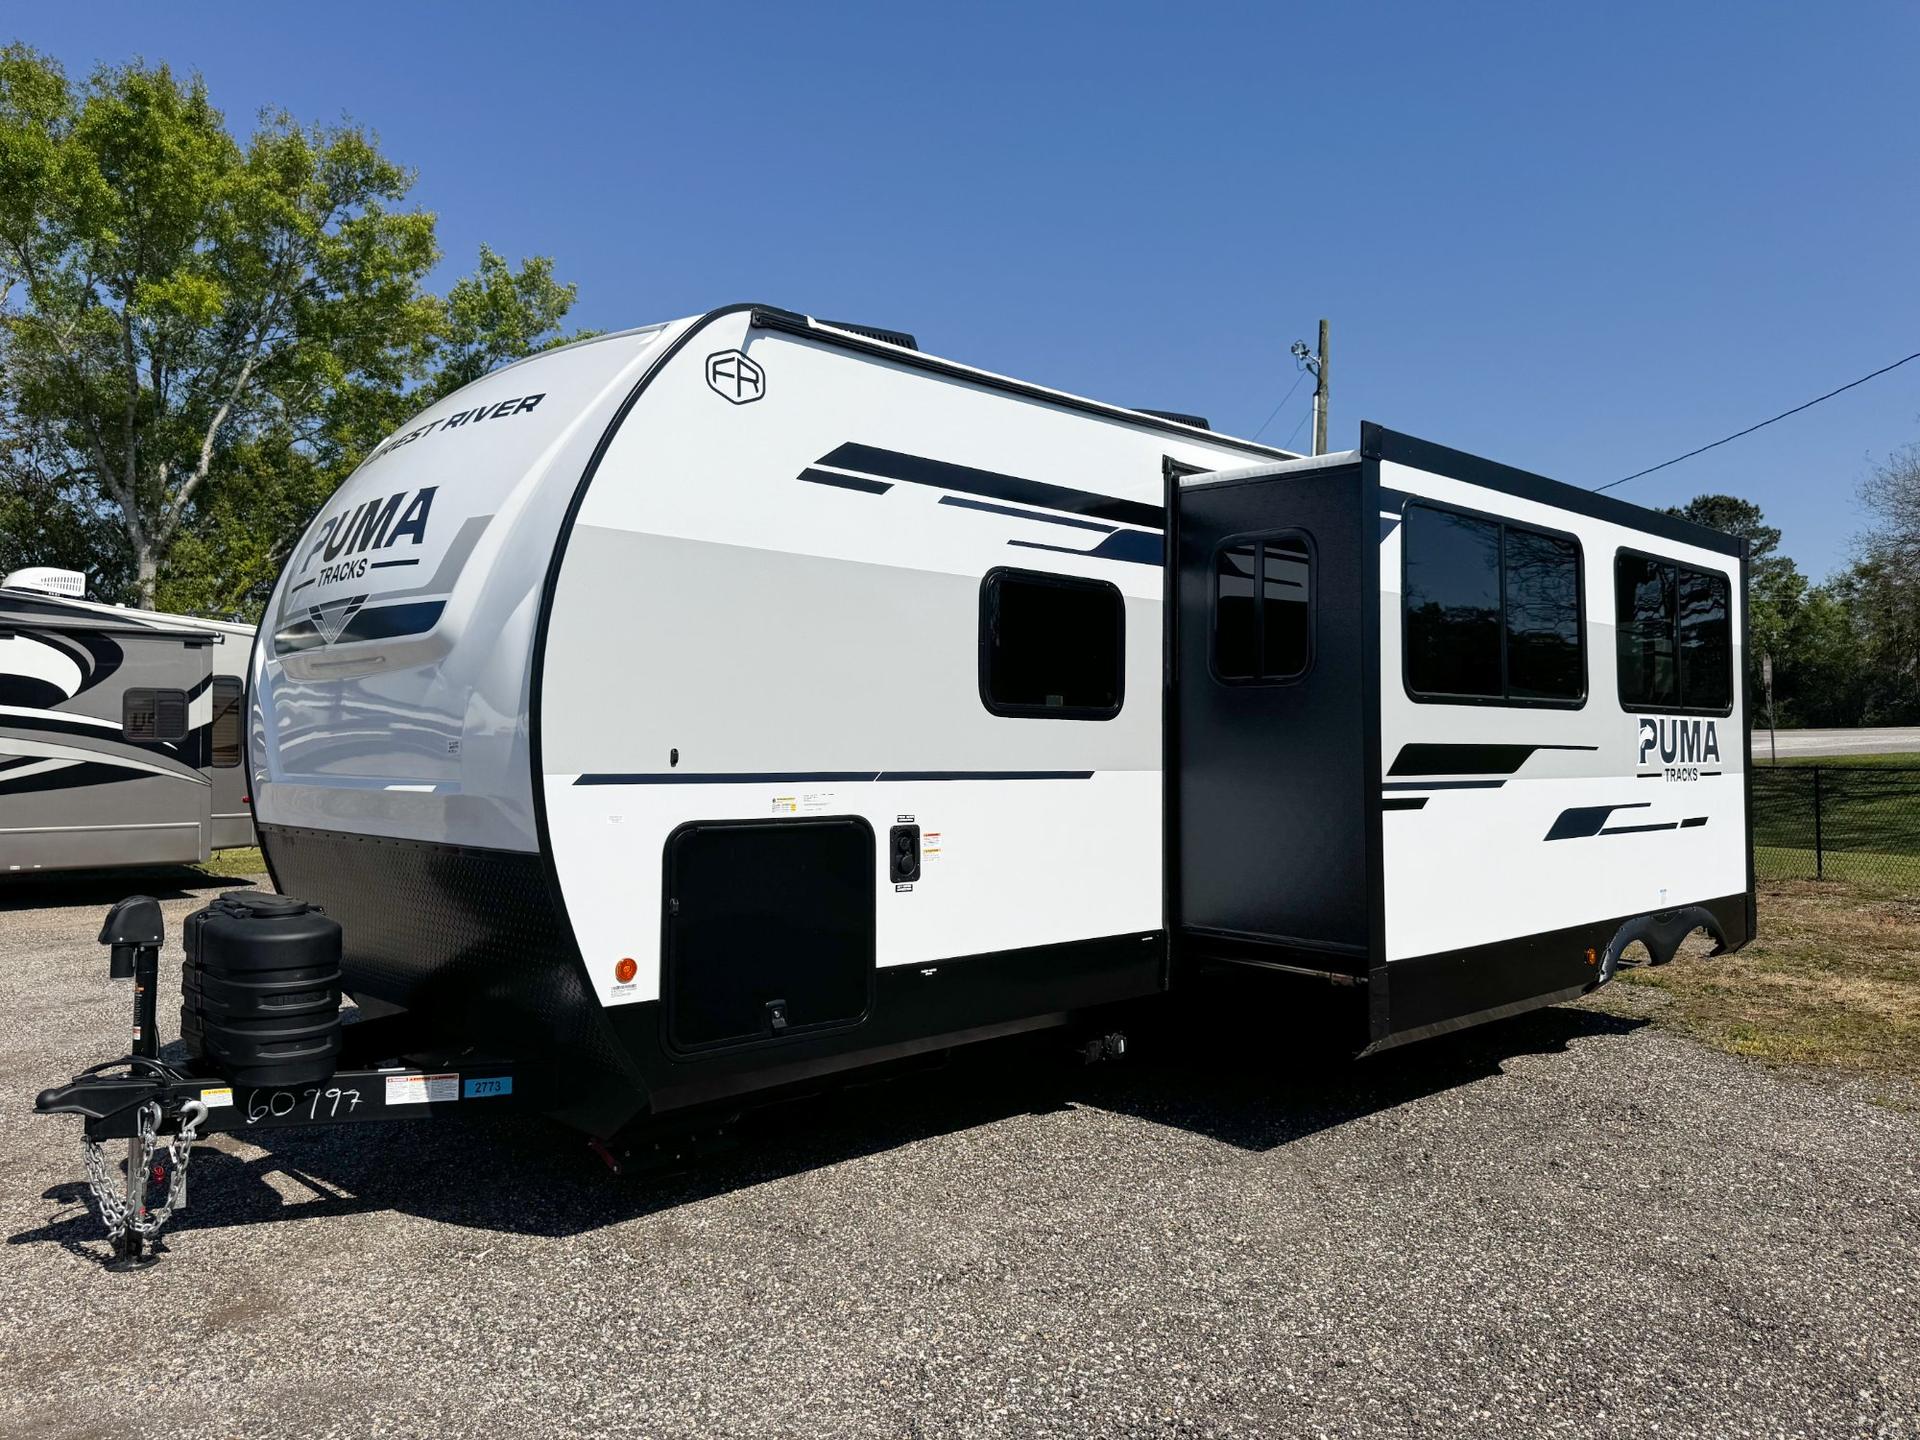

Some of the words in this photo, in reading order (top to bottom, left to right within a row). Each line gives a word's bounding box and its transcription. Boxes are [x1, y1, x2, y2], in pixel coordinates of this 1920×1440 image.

[440, 393, 547, 431] RIVER
[300, 485, 440, 575] PUMA
[317, 558, 368, 588] TRACKS
[1638, 718, 1721, 764] PUMA
[1664, 768, 1699, 782] TRACKS
[474, 1080, 502, 1094] 2773
